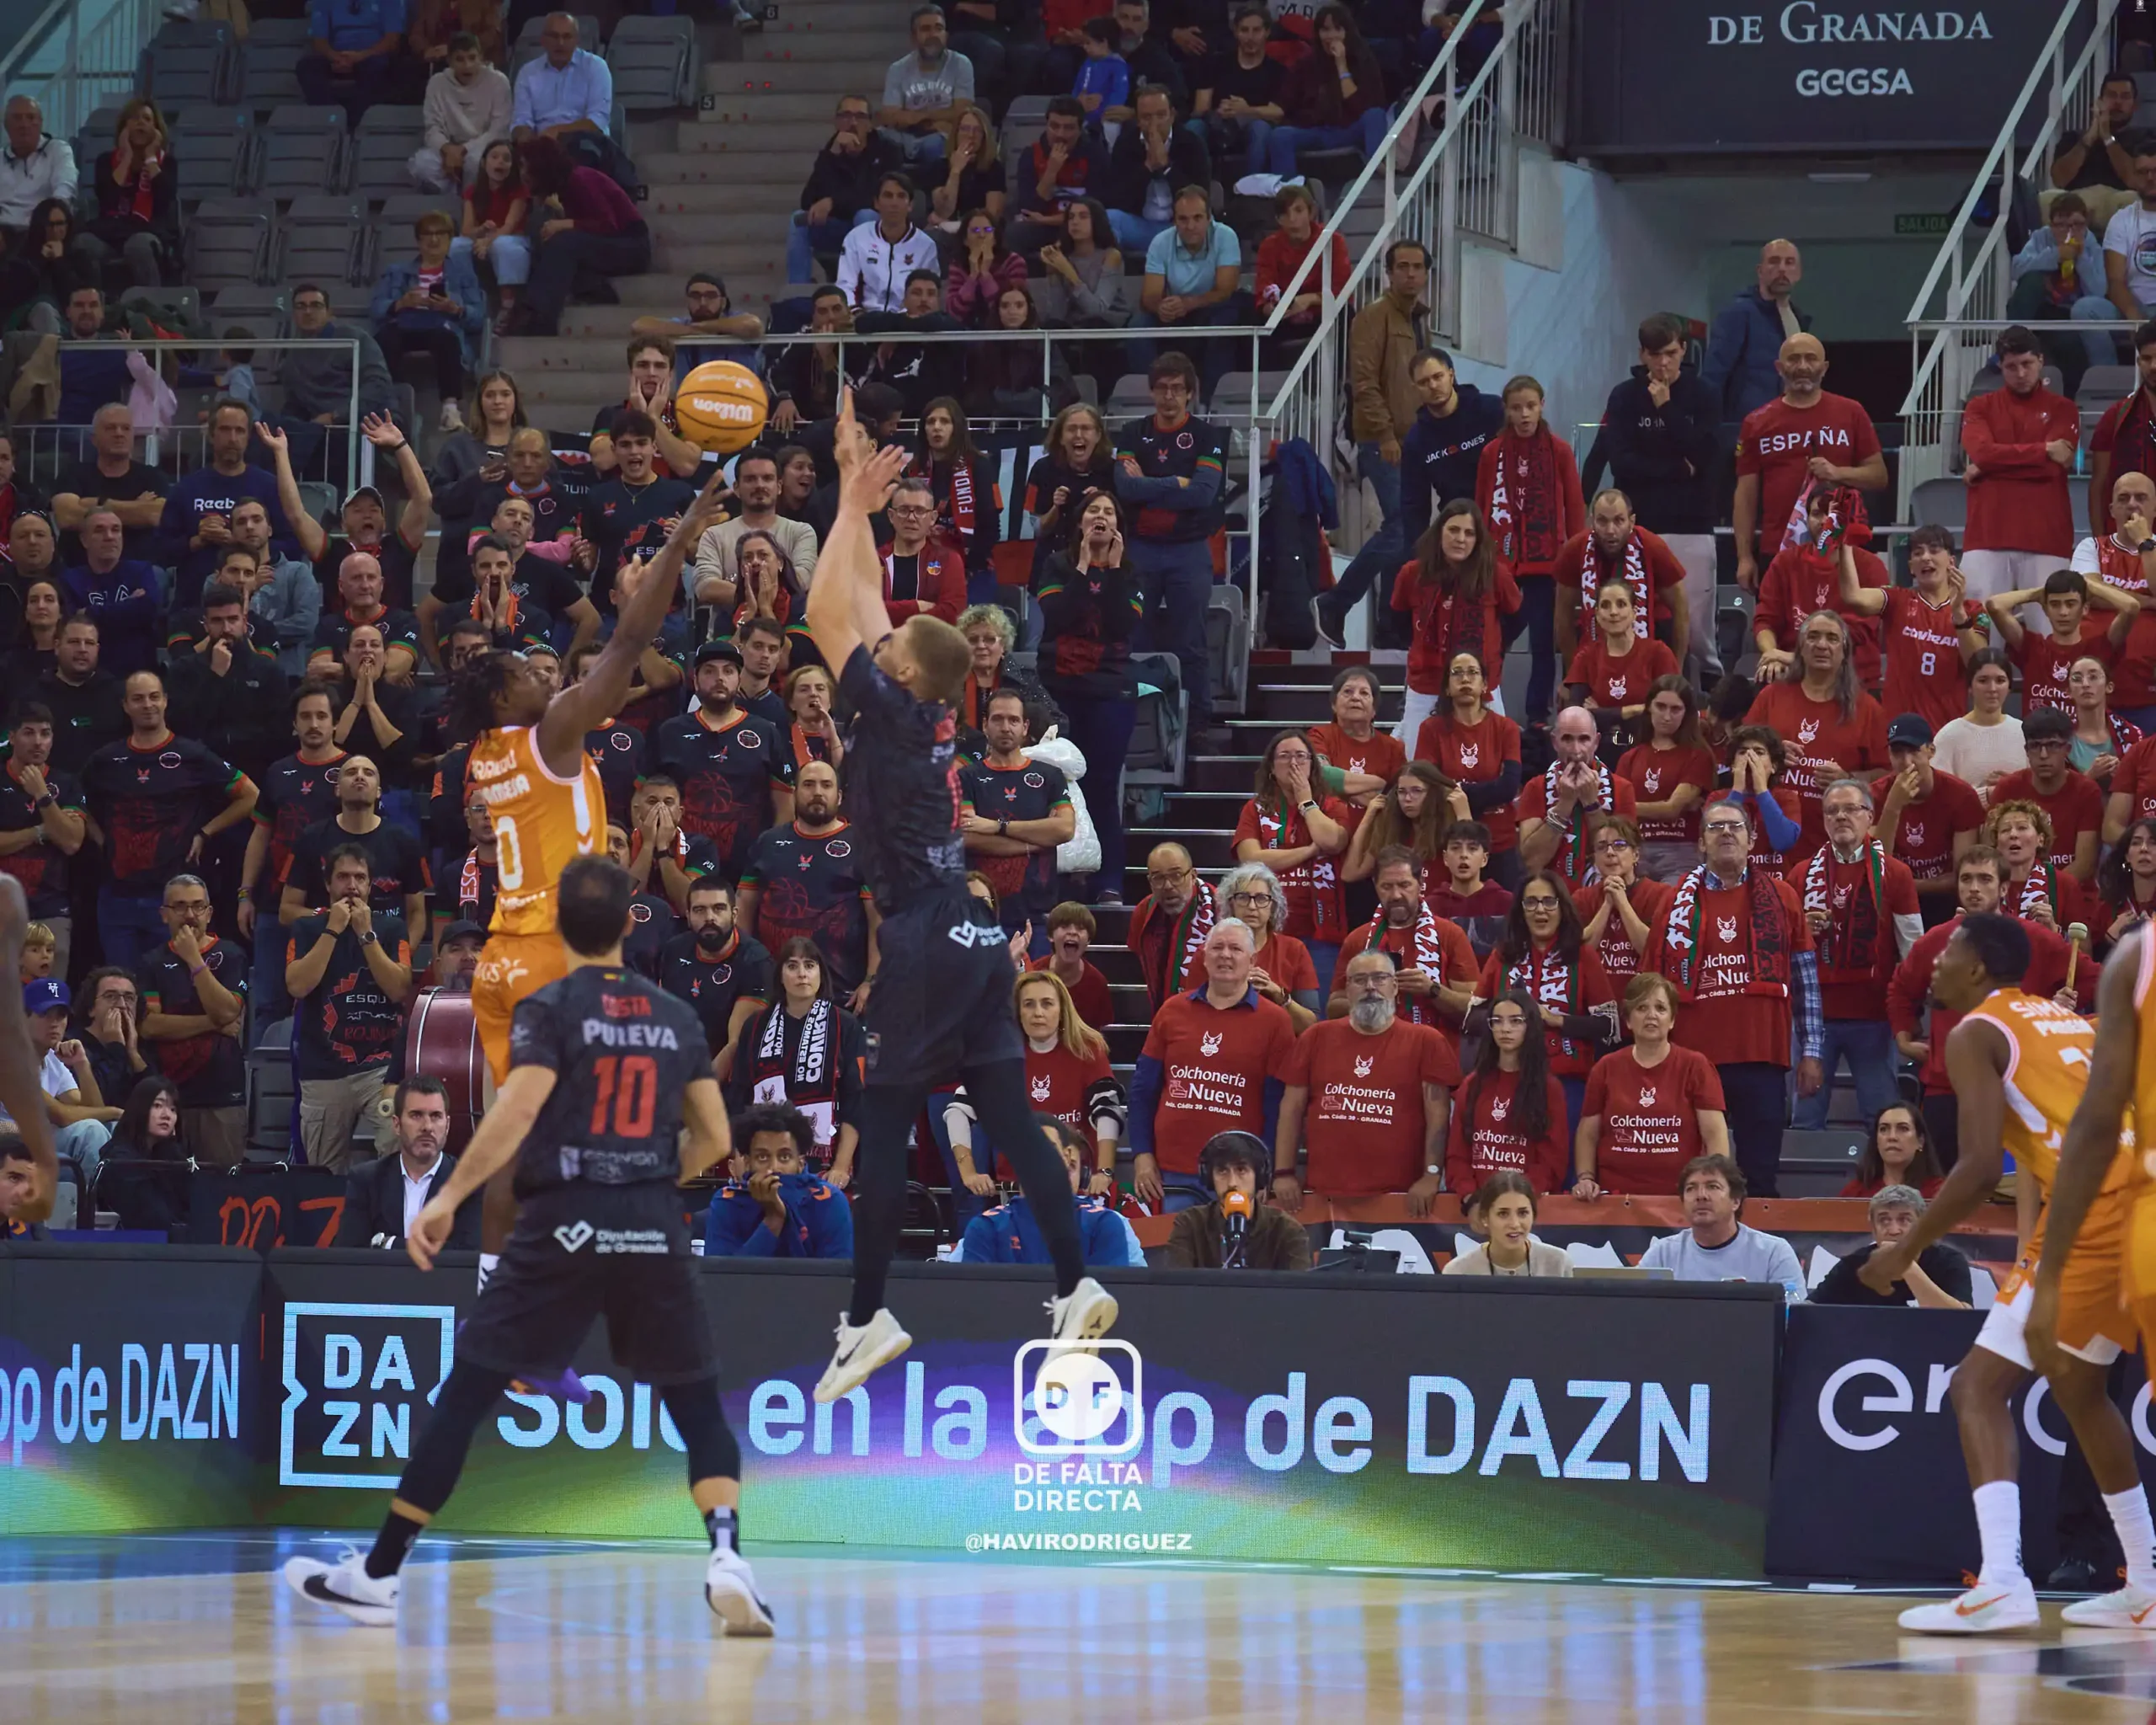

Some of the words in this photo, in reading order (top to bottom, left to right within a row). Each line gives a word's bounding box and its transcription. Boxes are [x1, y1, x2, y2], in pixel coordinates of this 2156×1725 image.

[1708, 15, 1764, 45] DE
[692, 398, 753, 422] Wilson
[1460, 433, 1486, 451] ONES
[954, 463, 974, 513] FUNDA
[194, 498, 236, 511] Reeb
[1921, 652, 1936, 676] 8
[1785, 768, 1817, 788] Nue
[497, 814, 523, 891] 0
[1602, 952, 1636, 967] Nuev
[582, 1017, 679, 1051] PULEVA
[1170, 1065, 1246, 1087] Colchonería
[590, 1055, 658, 1138] 10
[1187, 1082, 1243, 1107] Nueva
[1325, 1082, 1396, 1101] Colchonería
[1208, 1105, 1241, 1117] GRANADA
[1342, 1097, 1394, 1116] Nueva
[1360, 1116, 1392, 1124] GRANADA
[1610, 1114, 1682, 1129] Colchonería
[1632, 1130, 1679, 1145] Nueva
[1481, 1145, 1526, 1164] Nueva
[595, 1242, 612, 1253] de
[613, 1242, 669, 1254] Granada
[54, 1343, 108, 1444] de
[121, 1343, 239, 1441] DAZN
[749, 1380, 871, 1456] en
[903, 1361, 988, 1461] la
[1245, 1372, 1373, 1474] de
[1407, 1375, 1710, 1483] DAZN
